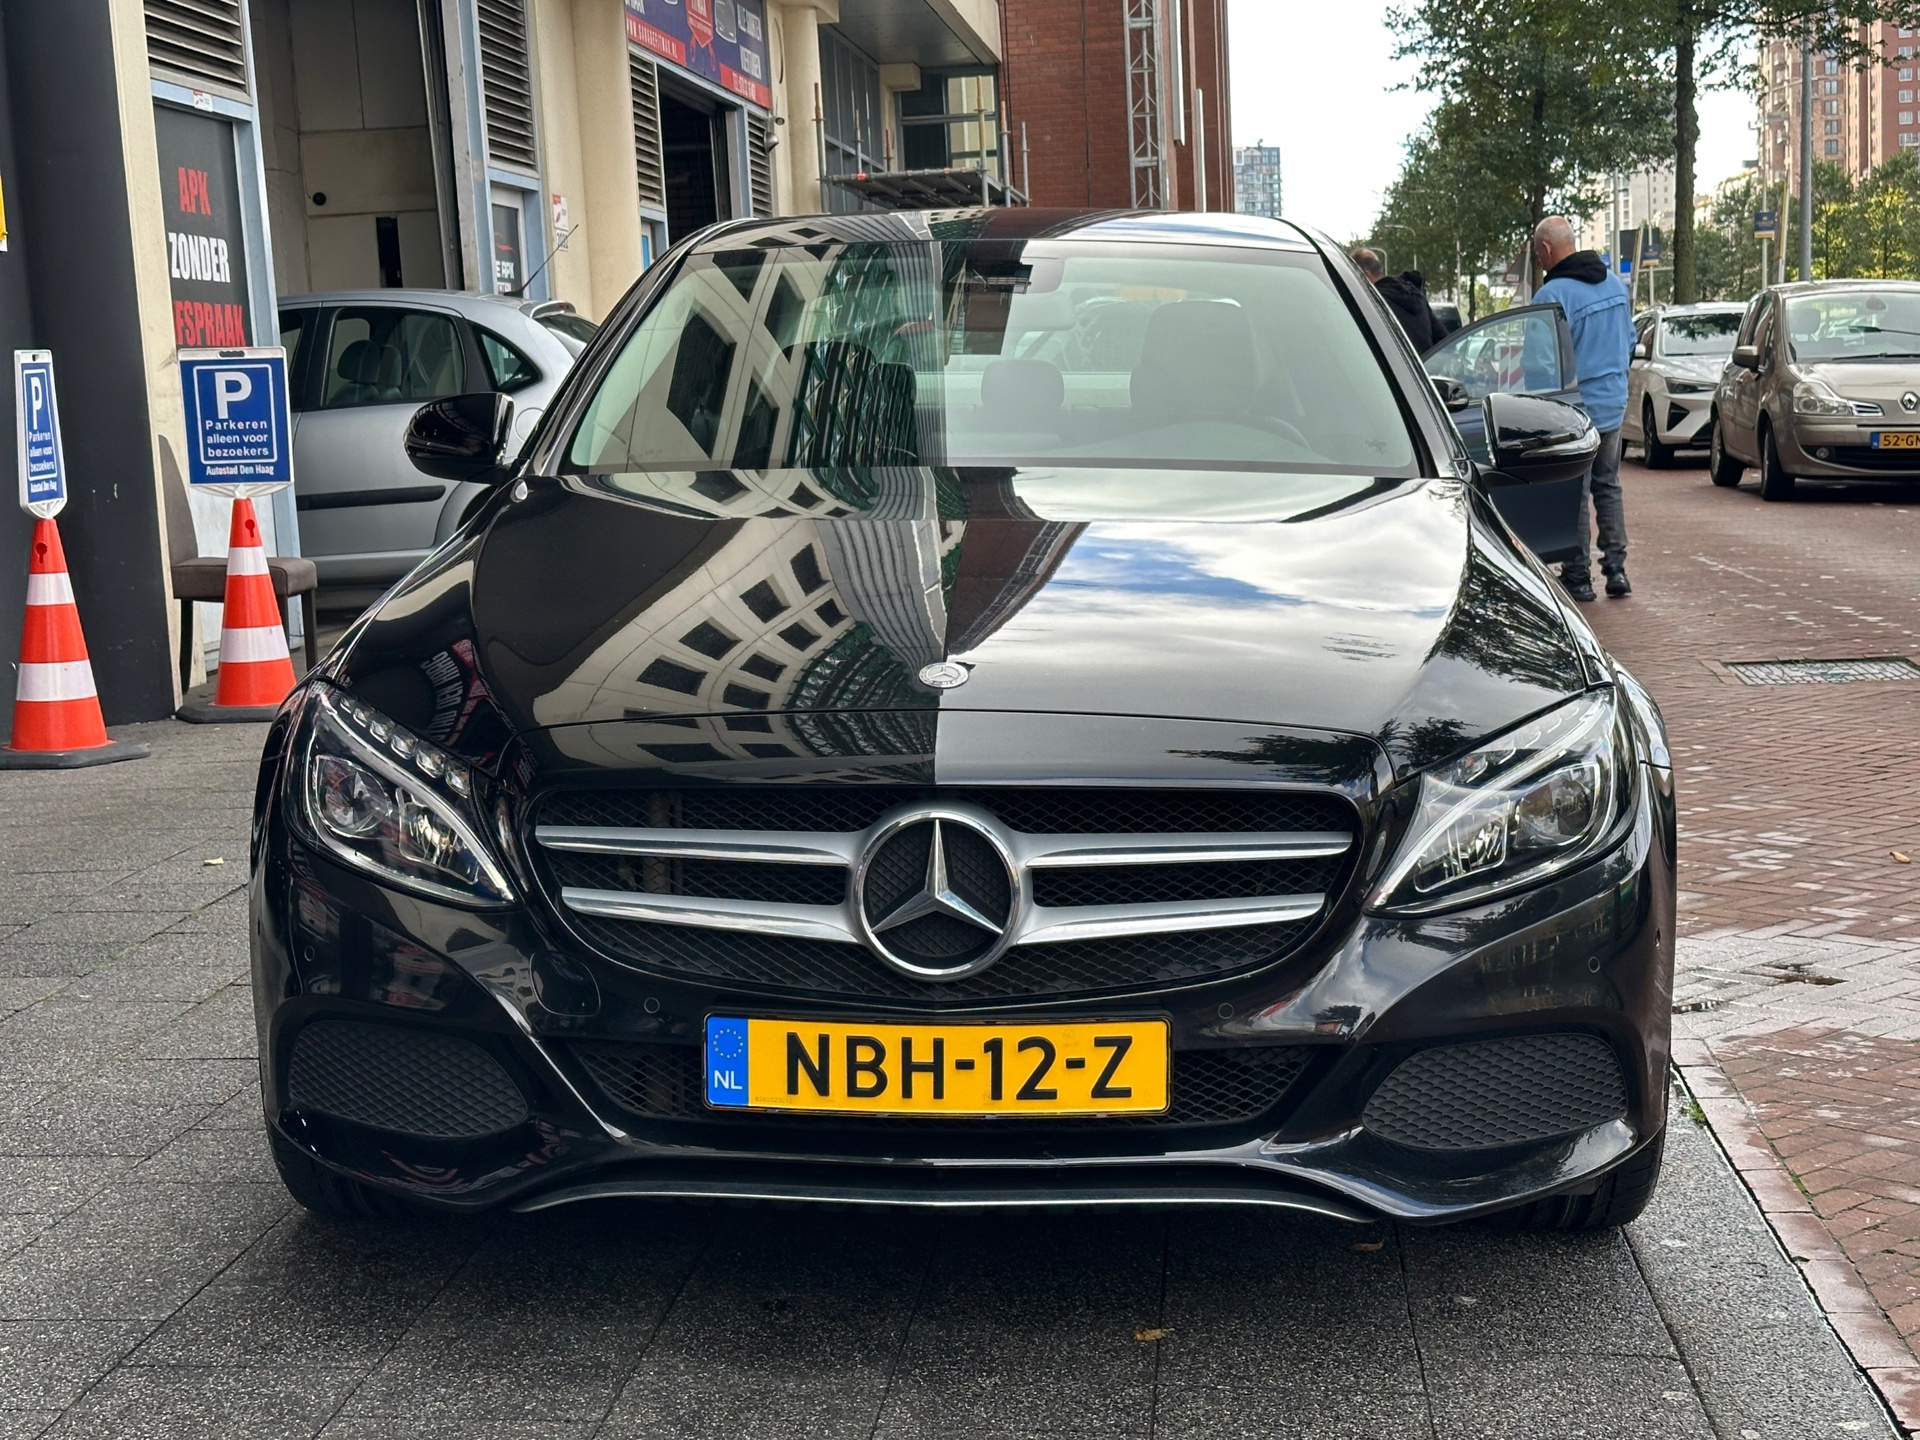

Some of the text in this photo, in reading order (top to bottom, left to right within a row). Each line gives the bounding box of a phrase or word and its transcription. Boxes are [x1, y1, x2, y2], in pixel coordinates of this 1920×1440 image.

[178, 166, 211, 215] APK
[168, 232, 231, 283] ZONDER
[174, 300, 246, 346] FSPRAAK
[30, 376, 42, 430] P
[215, 371, 252, 419] P
[205, 420, 267, 431] Parkeren
[29, 431, 51, 442] Parkeren
[207, 433, 268, 444] alleen voor
[208, 446, 269, 457] bezoekers
[31, 460, 54, 472] bezoekers
[206, 464, 275, 476] Autostad Den Haag
[786, 1032, 1133, 1101] NBH-12-Z
[714, 1070, 742, 1090] NL
